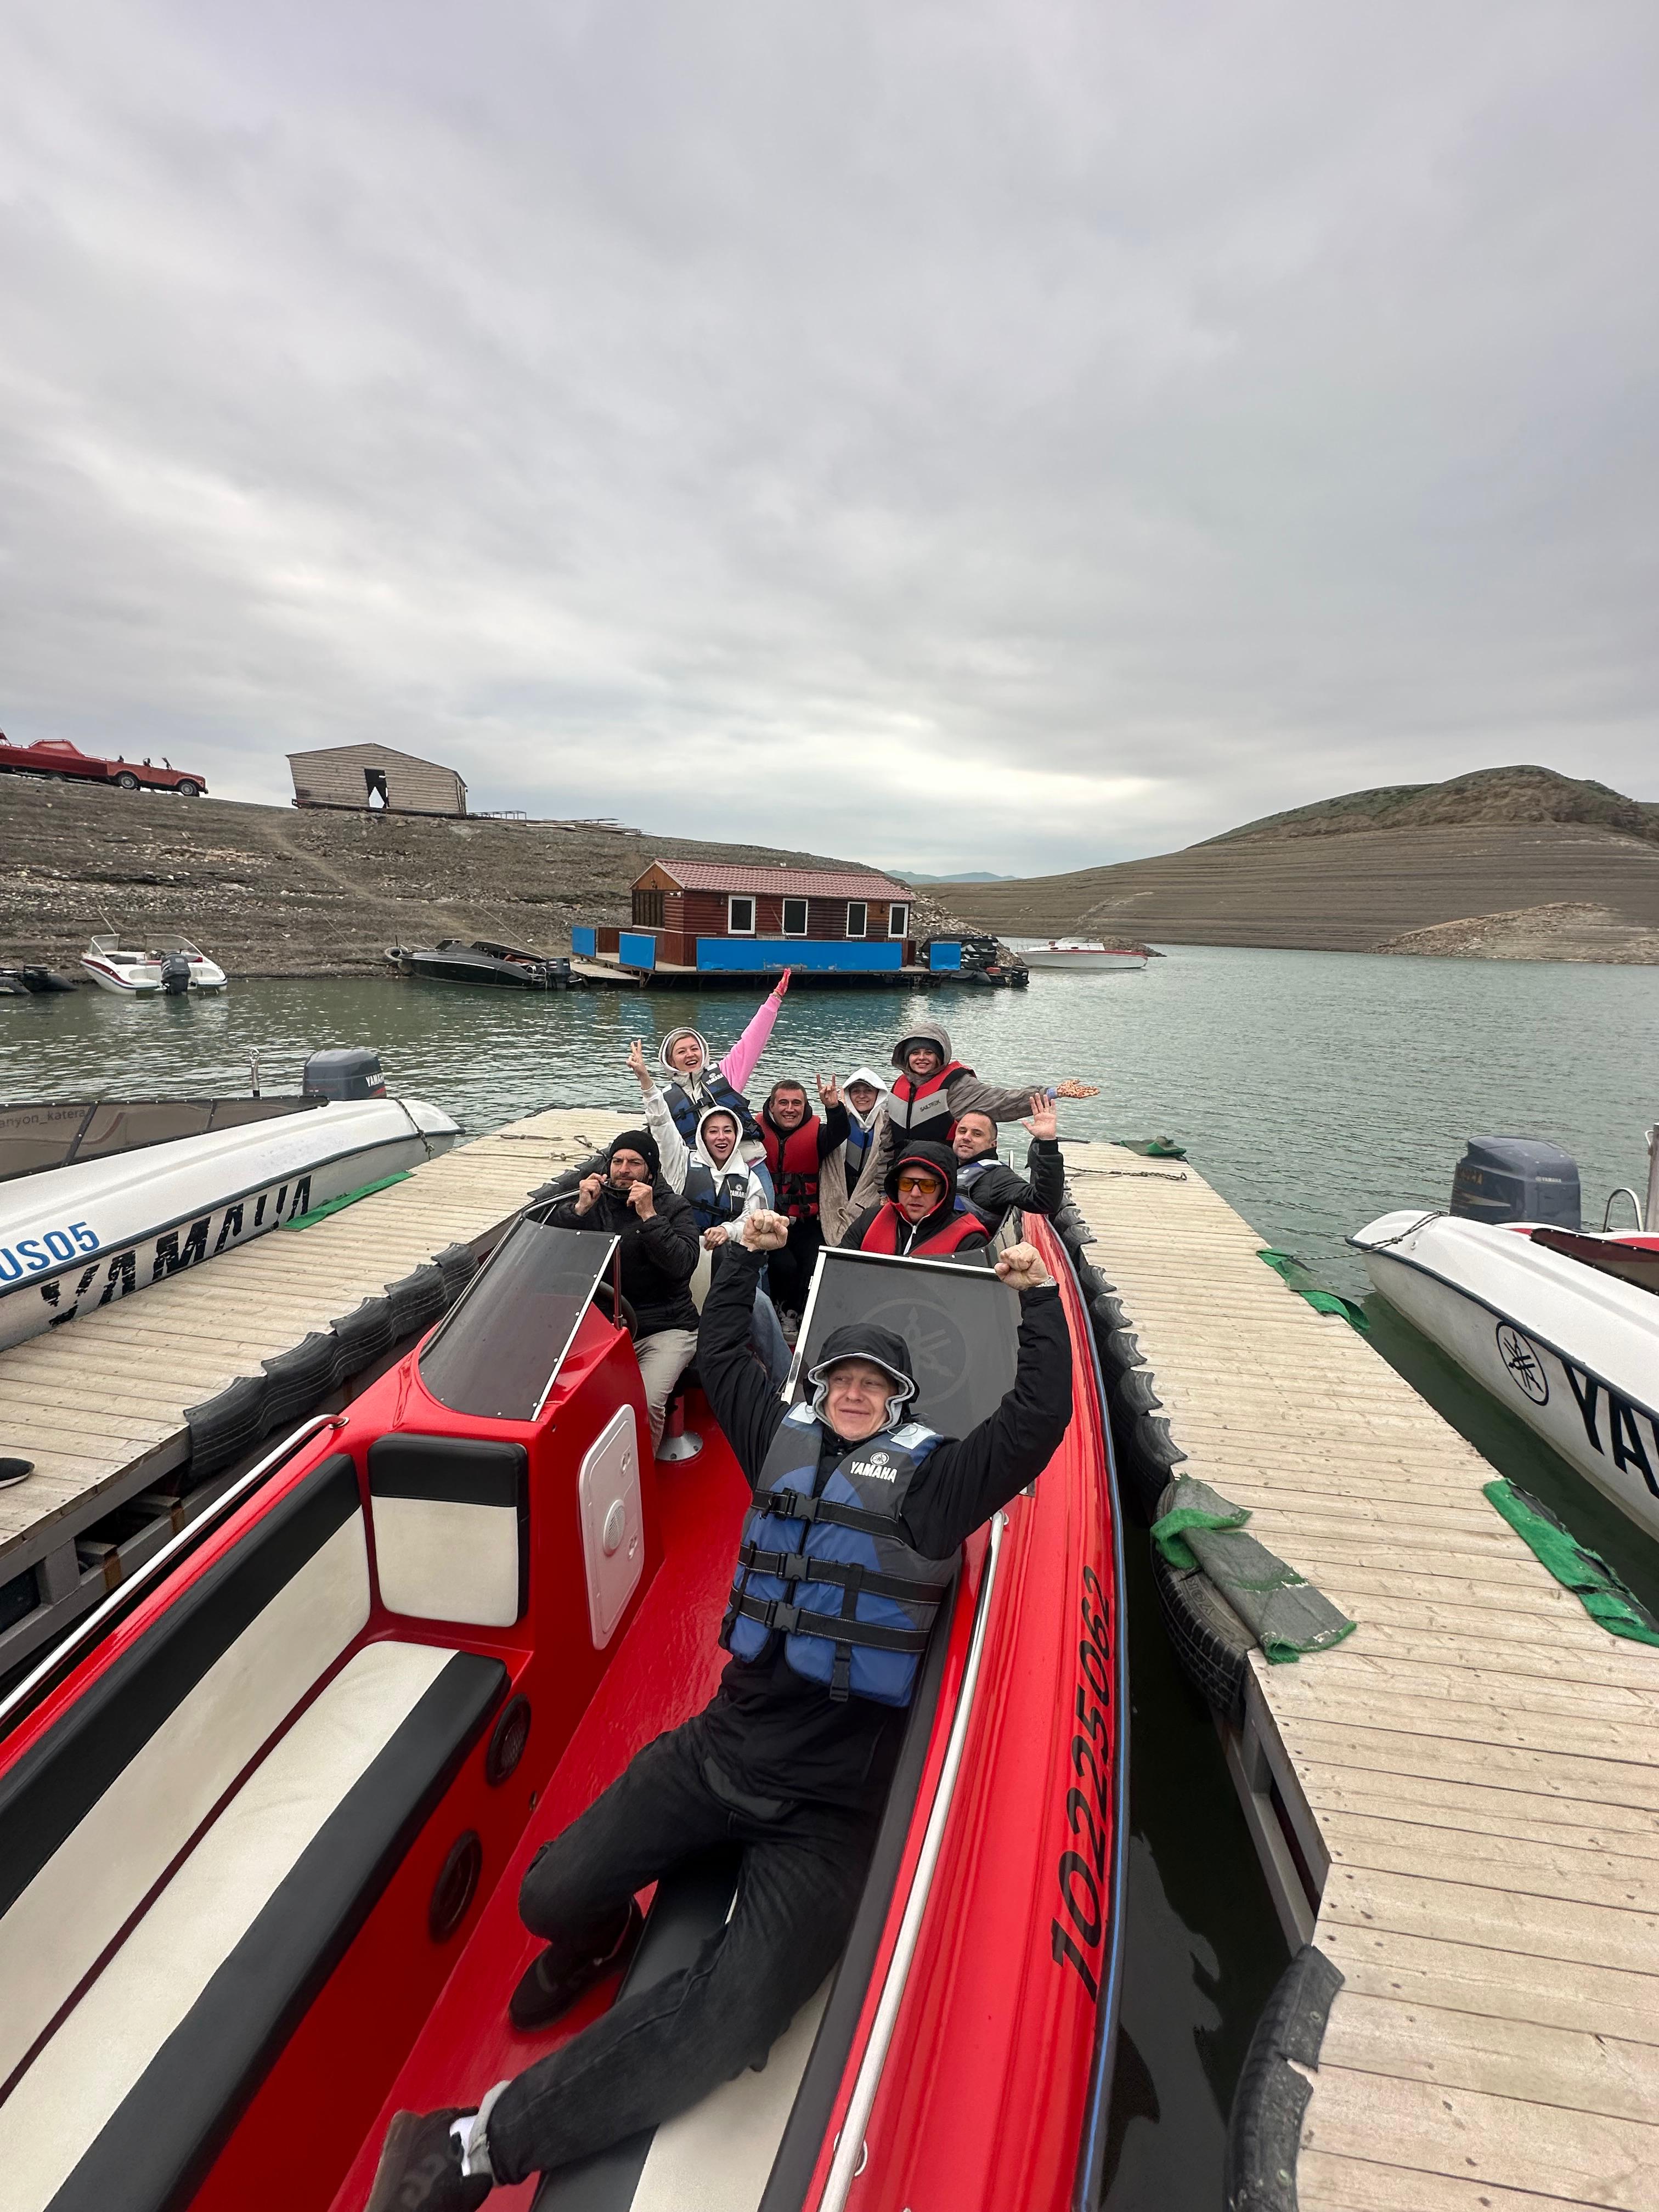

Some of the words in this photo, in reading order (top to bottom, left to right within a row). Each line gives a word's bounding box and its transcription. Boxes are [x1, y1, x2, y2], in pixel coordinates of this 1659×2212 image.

[850, 1462, 898, 1483] YAMAHA
[1561, 1359, 1659, 1499] YA
[1049, 1565, 1111, 2003] 10225062
